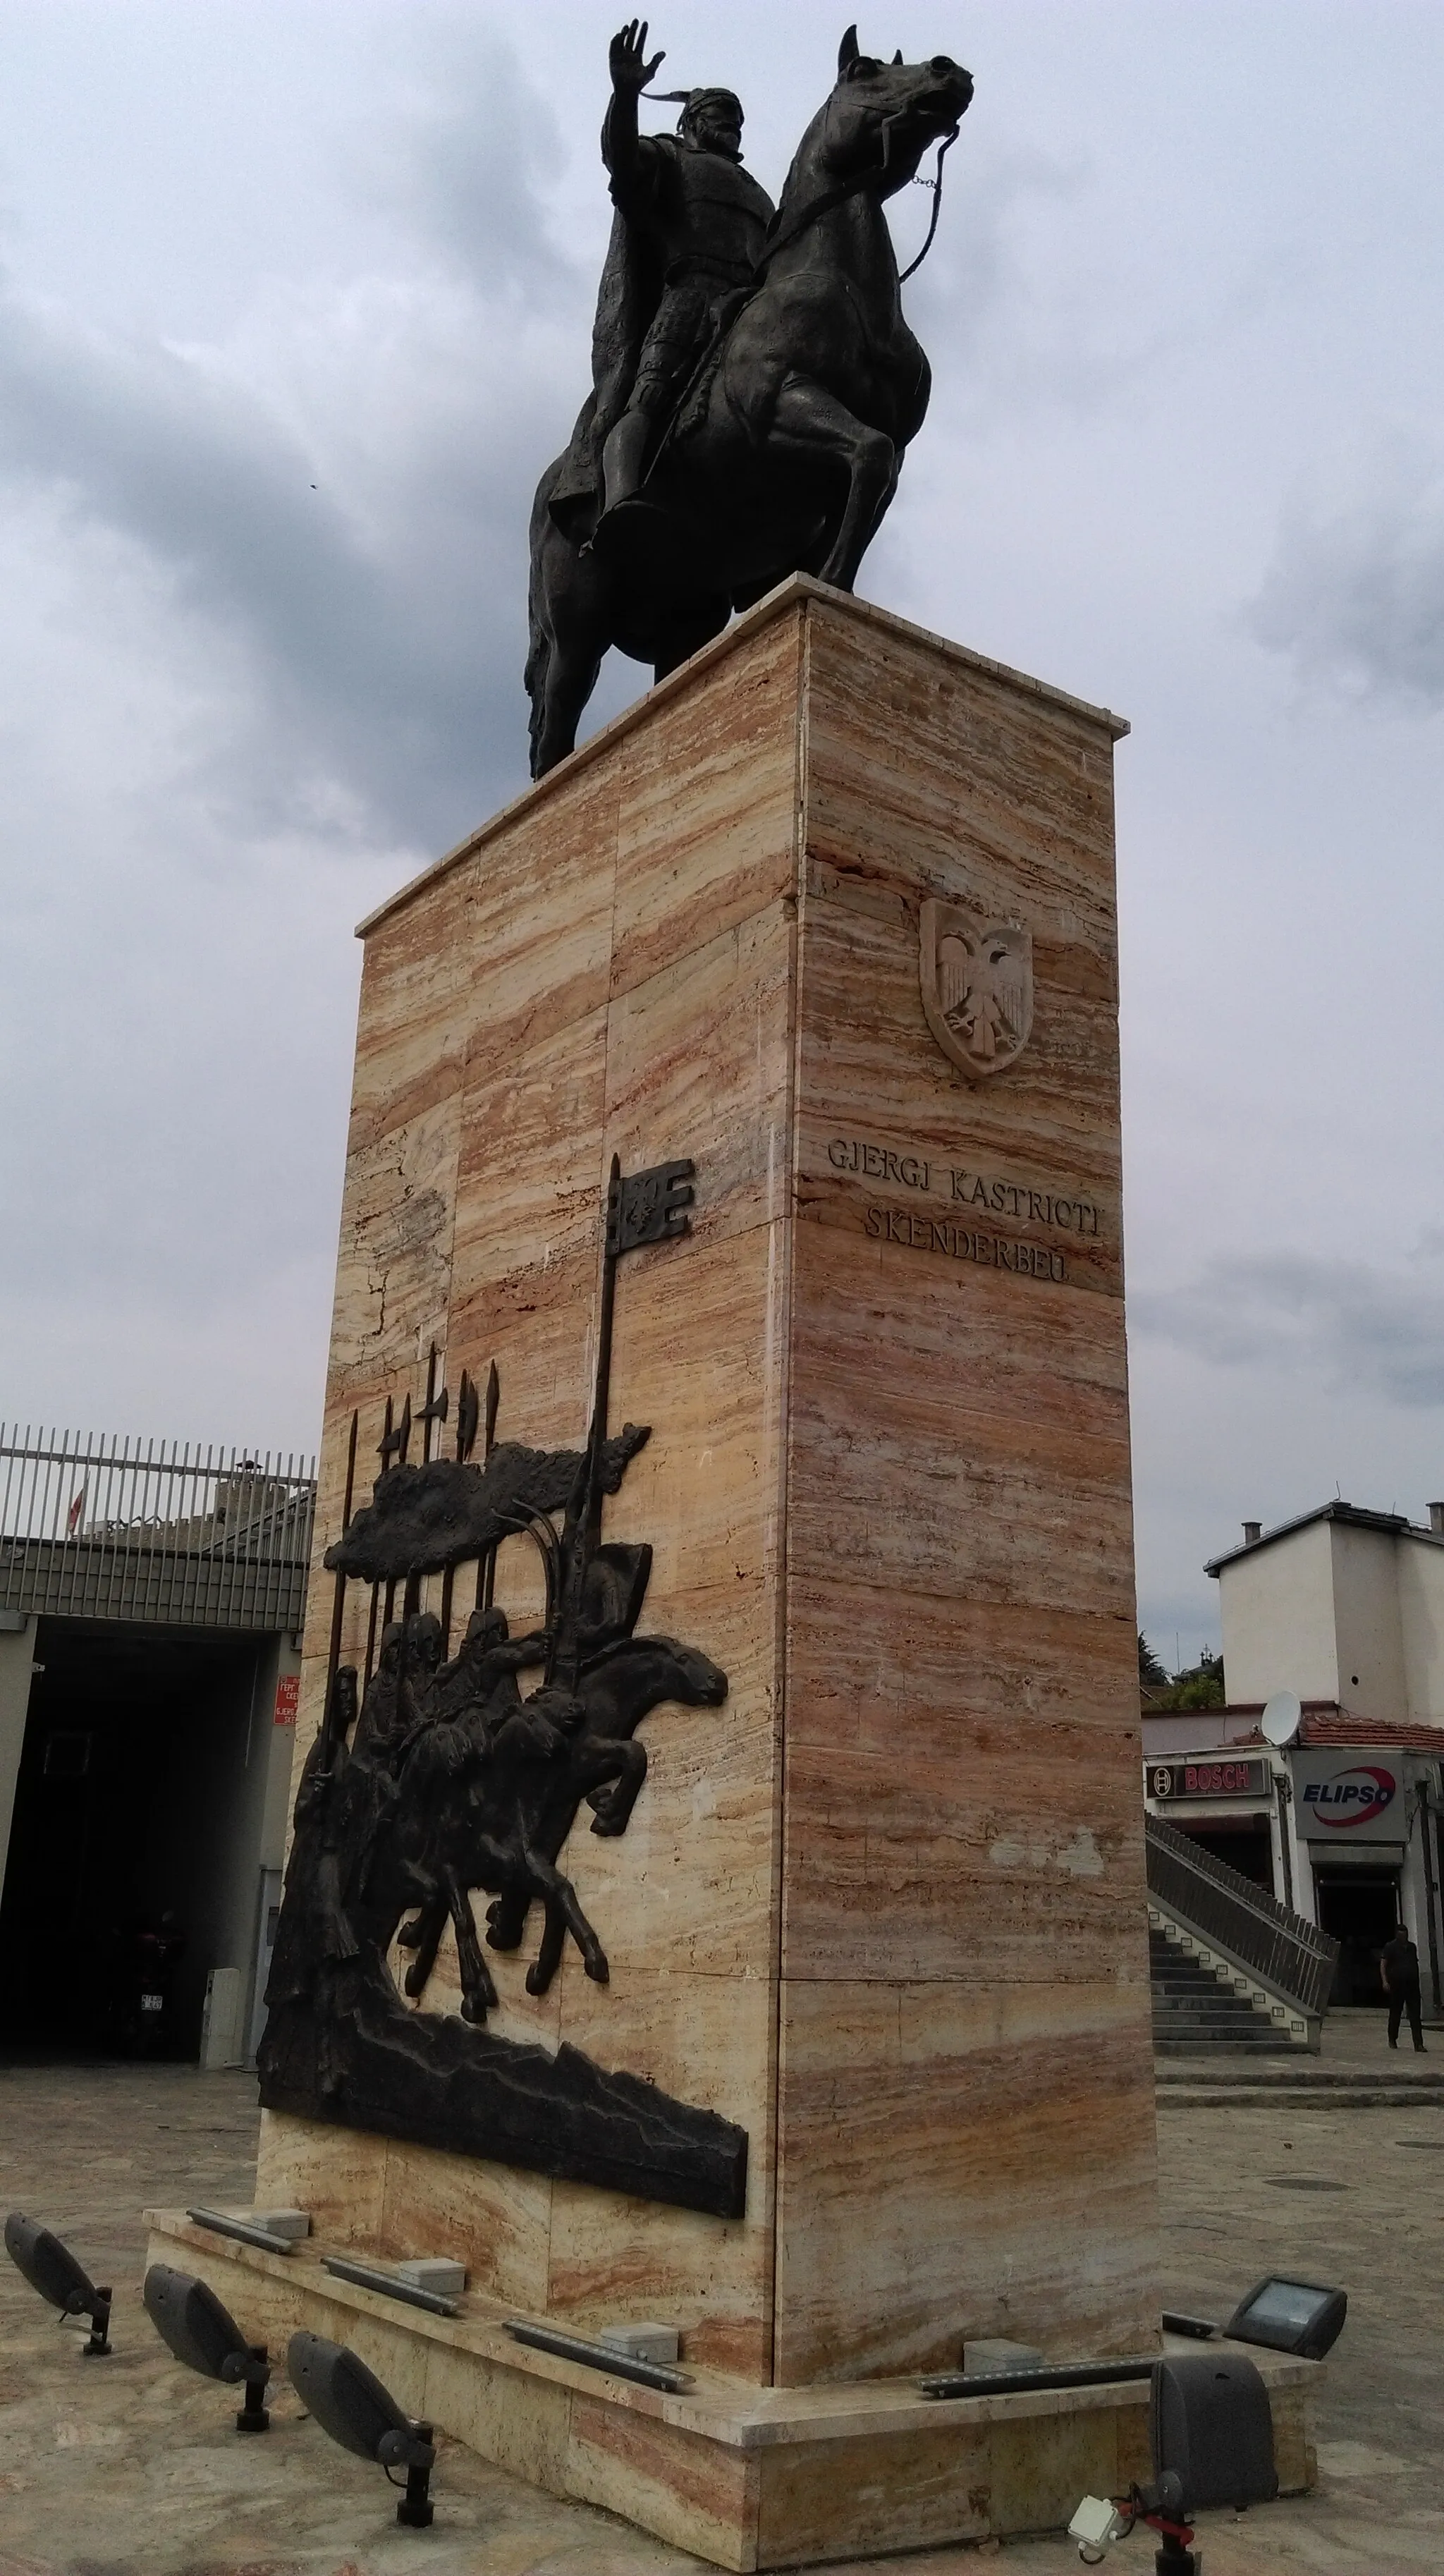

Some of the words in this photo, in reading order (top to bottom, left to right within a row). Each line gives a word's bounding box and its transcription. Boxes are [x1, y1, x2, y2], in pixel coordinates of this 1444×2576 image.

[828, 1138, 931, 1191] GJERGJ
[950, 1168, 1106, 1237] KASTRIOTI
[865, 1207, 1067, 1282] SKENDERBEU
[1185, 1764, 1249, 1790] BOSCH
[1303, 1783, 1394, 1805] ELIPSO
